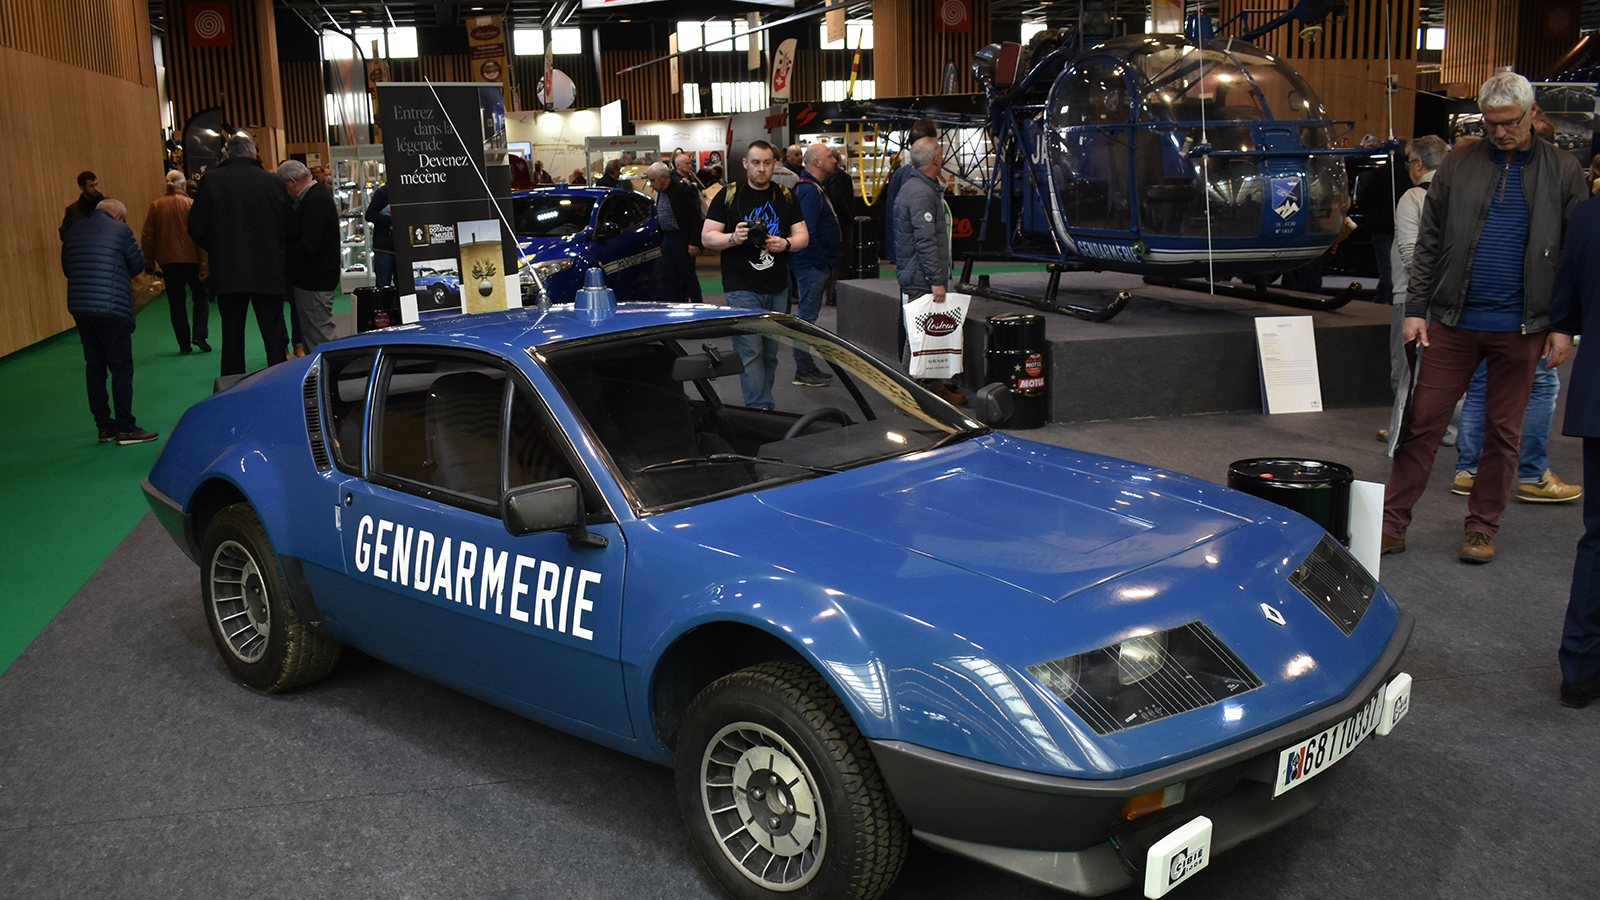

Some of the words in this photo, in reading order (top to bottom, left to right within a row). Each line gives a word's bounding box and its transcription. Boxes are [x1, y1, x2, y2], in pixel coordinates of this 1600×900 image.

[394, 106, 434, 119] Entrez
[414, 121, 442, 135] dans
[443, 120, 454, 135] la
[396, 136, 442, 156] légende
[418, 153, 469, 168] Devenez
[400, 168, 447, 185] mécène
[1077, 240, 1142, 263] GENDARMERIE
[1020, 378, 1045, 388] MOTUL
[355, 515, 602, 641] GENDARMERIE
[1176, 848, 1203, 872] CIBIE
